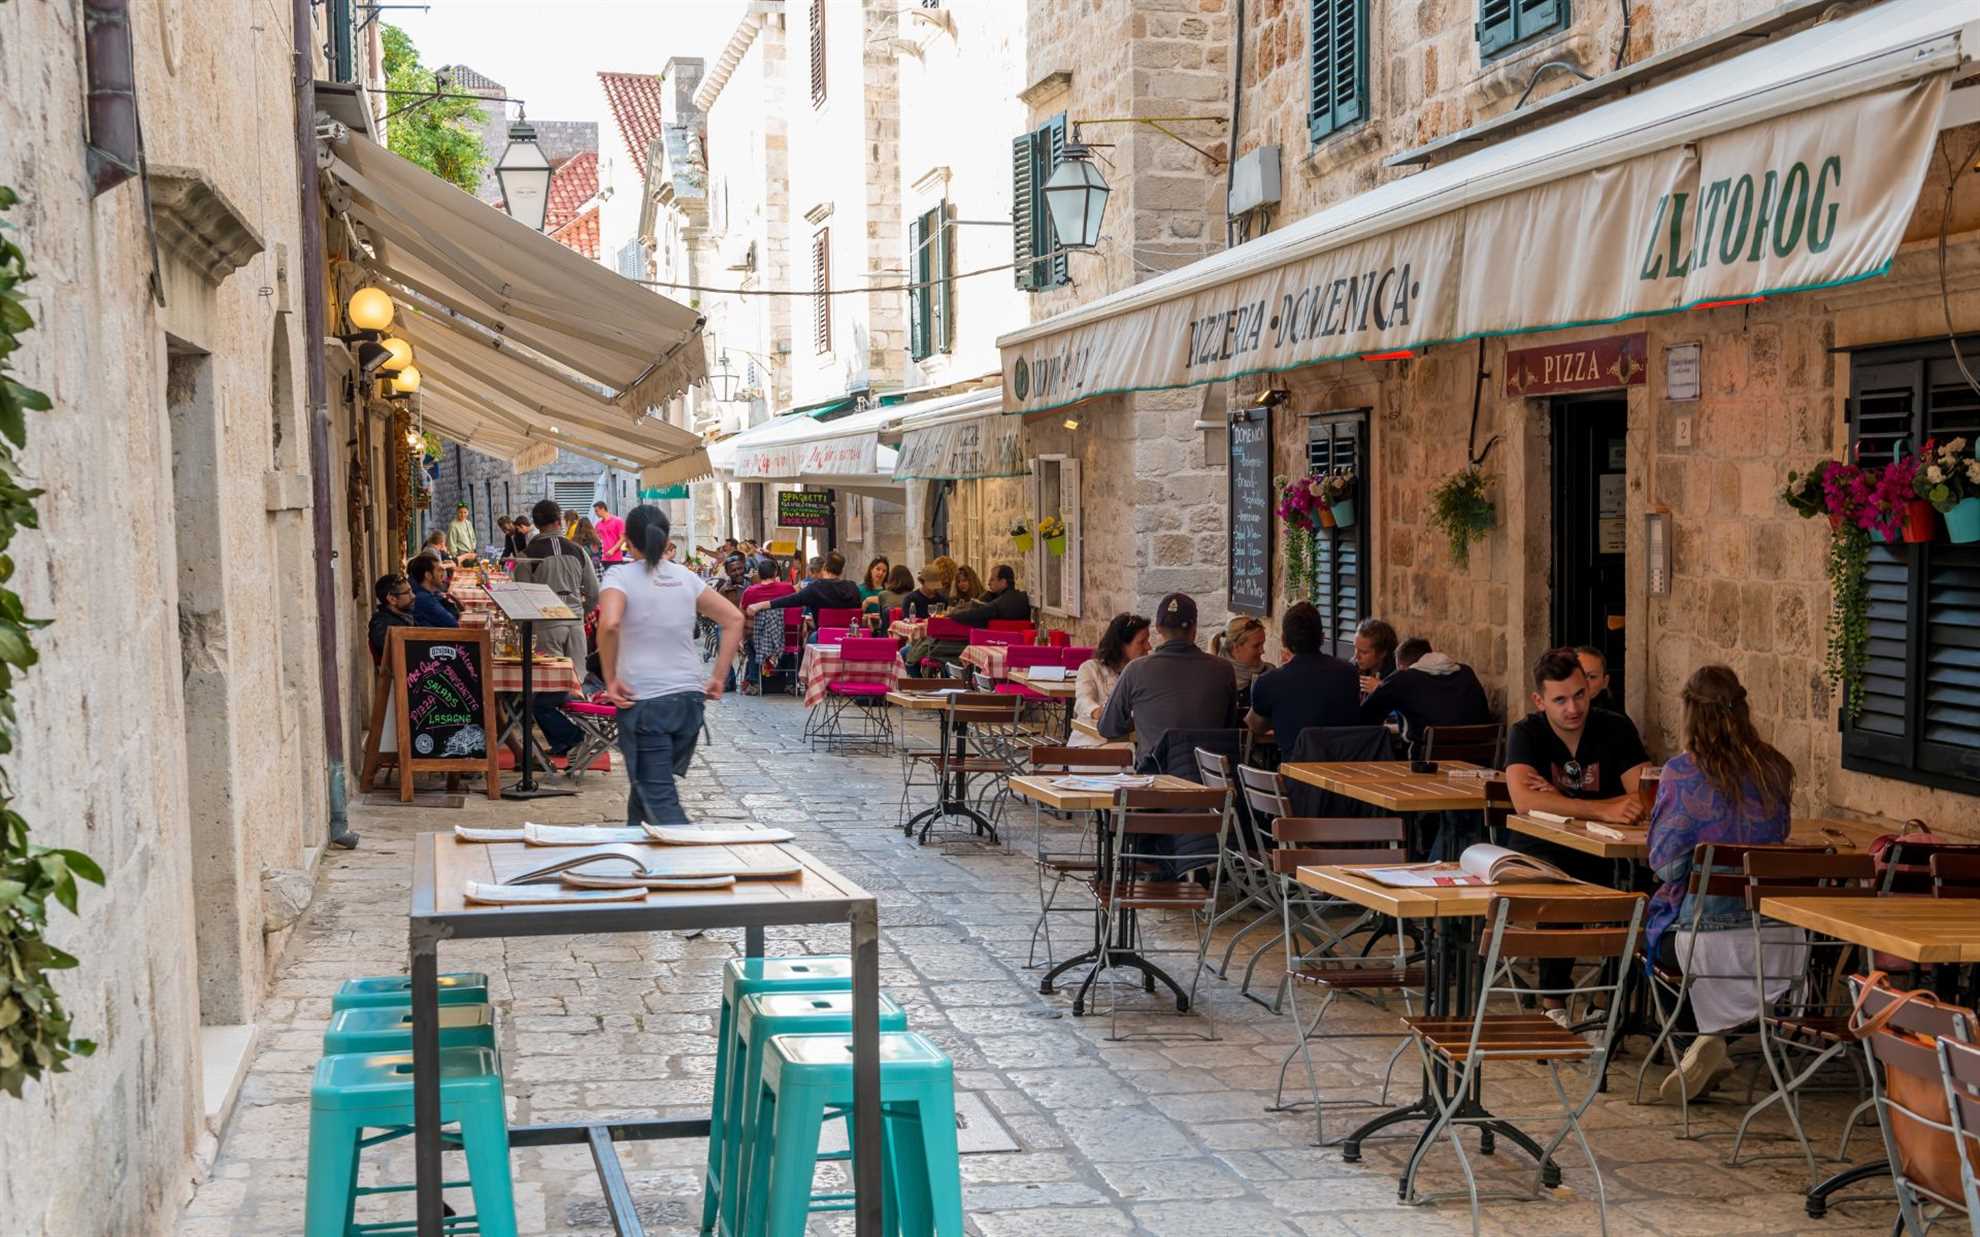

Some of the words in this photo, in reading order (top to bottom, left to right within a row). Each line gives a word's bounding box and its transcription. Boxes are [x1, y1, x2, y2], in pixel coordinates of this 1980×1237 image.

[1543, 351, 1601, 385] PIZZA
[1680, 421, 1688, 440] 2
[424, 679, 460, 709] SALADS
